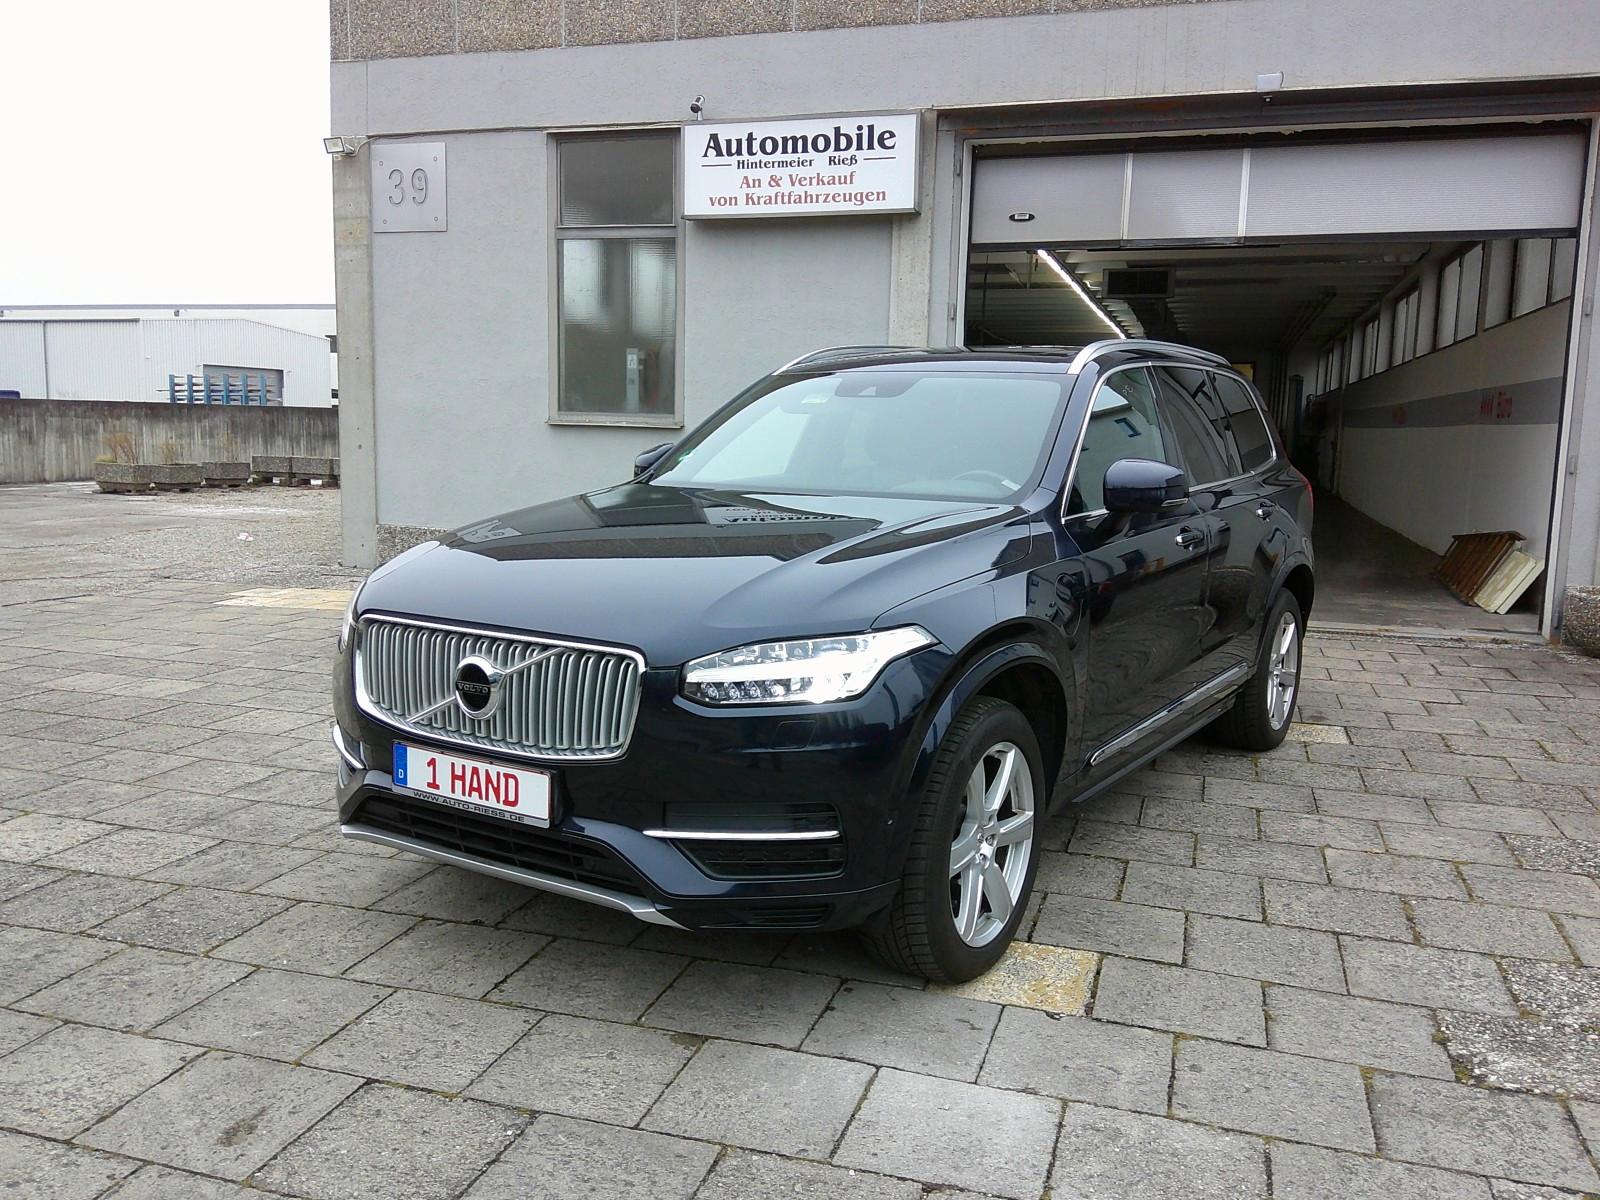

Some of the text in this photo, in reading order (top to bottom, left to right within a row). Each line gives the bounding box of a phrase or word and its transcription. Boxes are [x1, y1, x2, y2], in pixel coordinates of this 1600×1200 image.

[702, 123, 897, 158] Automobile
[736, 154, 858, 170] Hintermeier Rieß
[388, 168, 428, 206] 39
[739, 171, 857, 189] An & Verkauf
[708, 188, 887, 207] von Kraftfahrzeugen
[457, 682, 489, 694] VOLVO
[398, 768, 405, 779] D
[426, 757, 520, 808] 1 HAND
